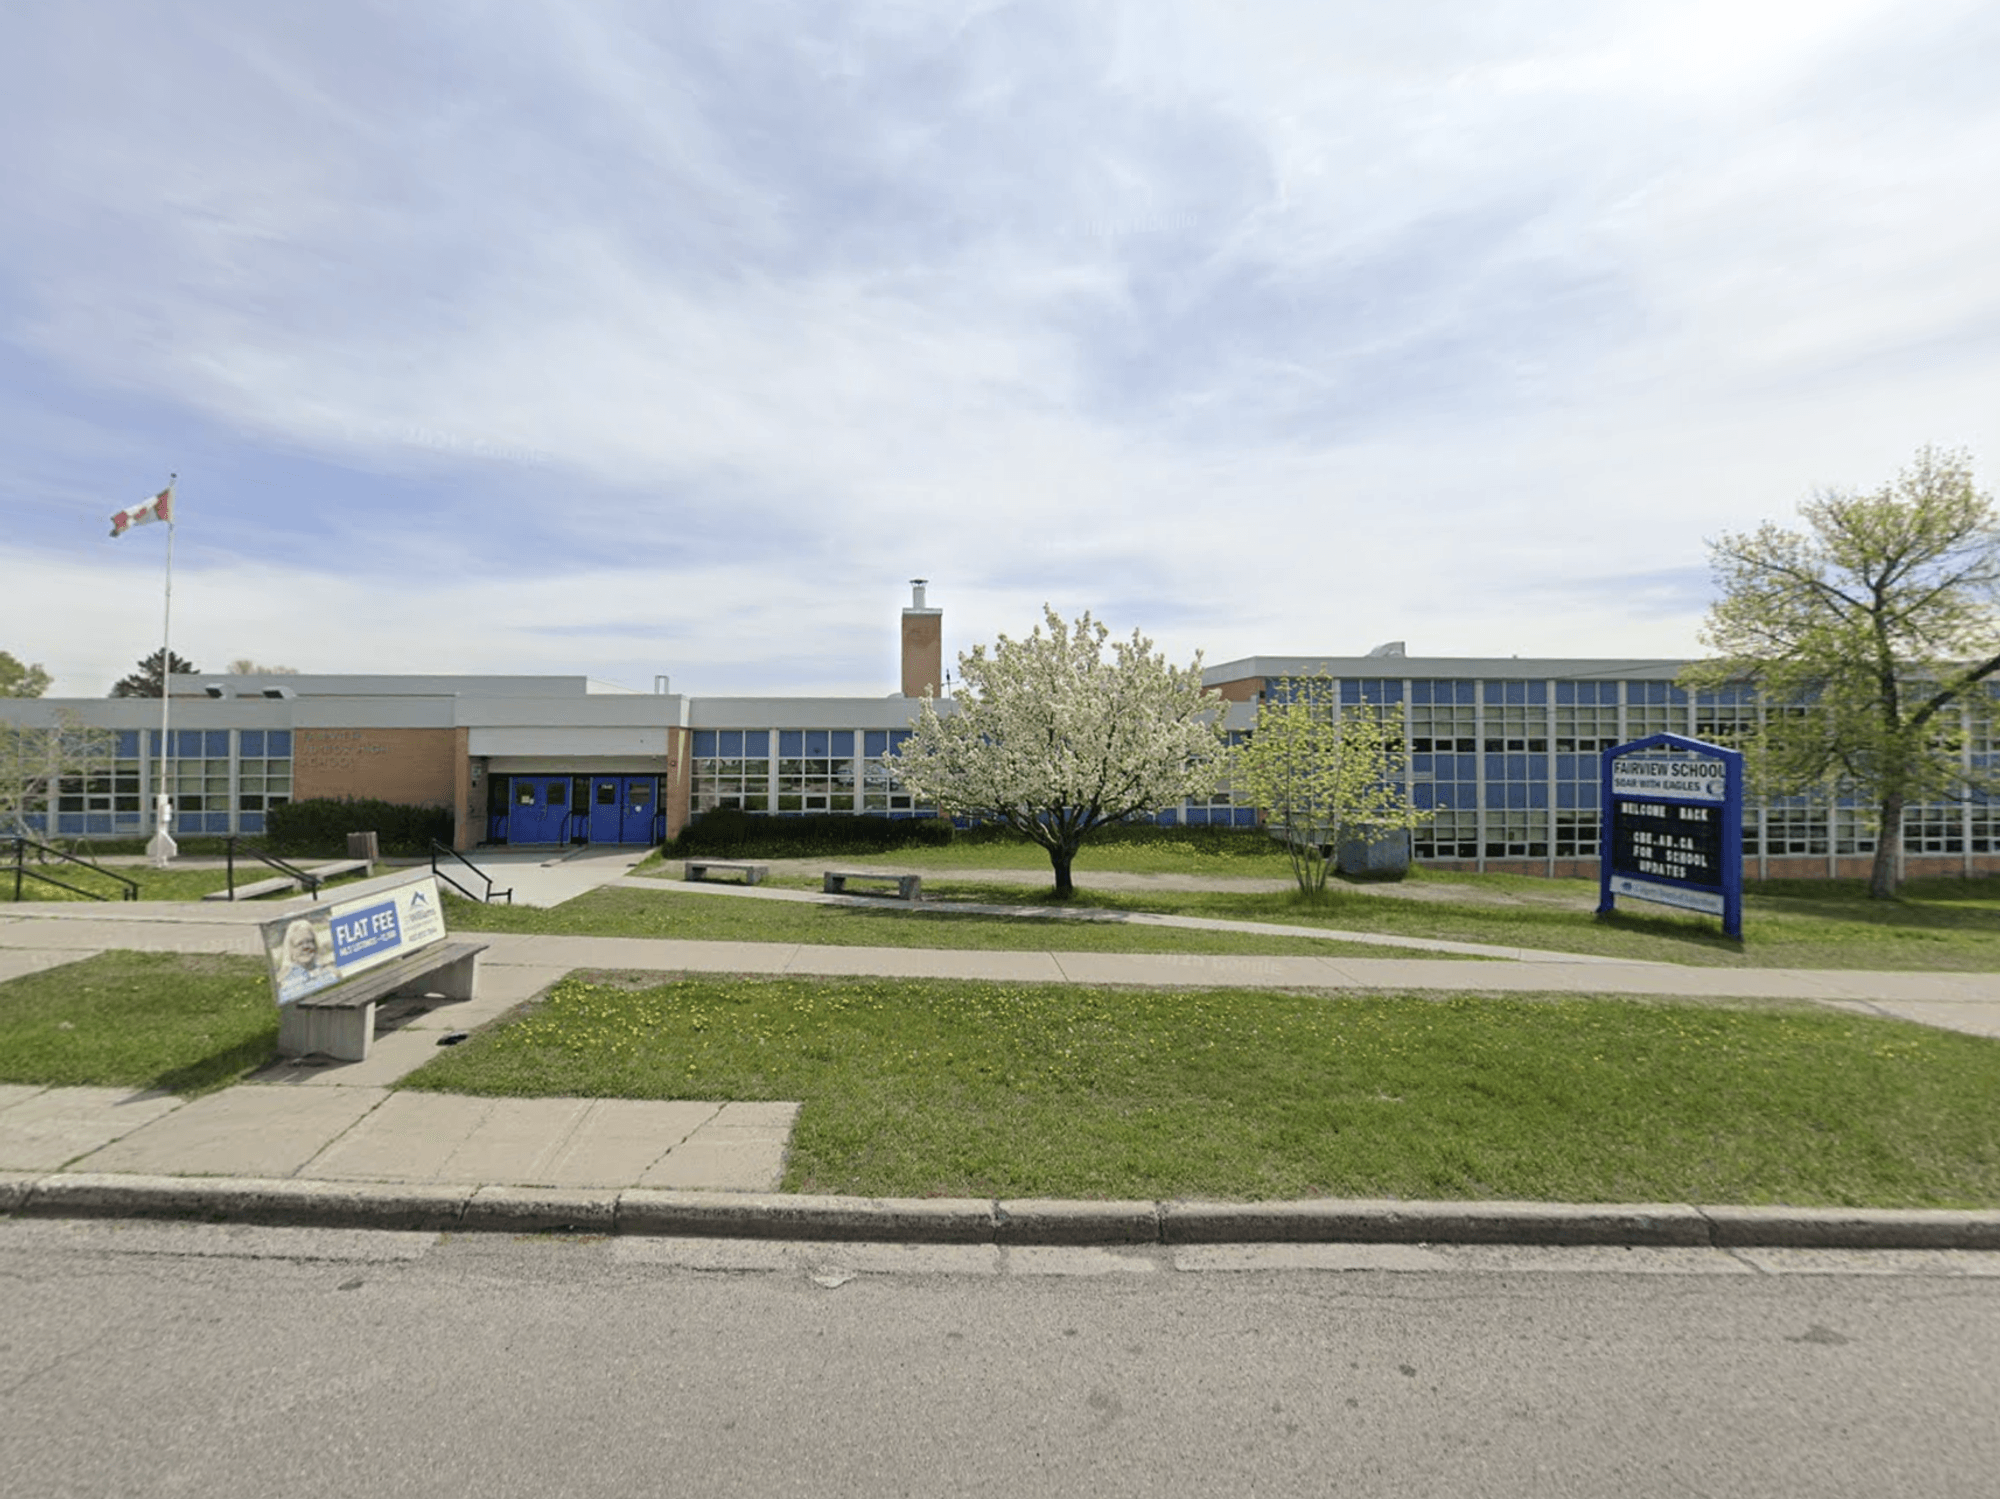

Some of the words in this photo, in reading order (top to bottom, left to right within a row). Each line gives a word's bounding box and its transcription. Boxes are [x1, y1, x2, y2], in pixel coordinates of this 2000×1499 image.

[1614, 762, 1669, 776] FAIRVIEW
[1671, 763, 1725, 778] SCHOOL
[1662, 781, 1701, 792] EAGLES
[1621, 802, 1666, 818] WELCOME
[1679, 807, 1709, 821] BACK
[1633, 845, 1653, 858] FOR
[1666, 850, 1708, 868] SCHOOL
[1639, 860, 1687, 878] UPDATES
[336, 917, 369, 947] FLAT
[371, 909, 396, 935] FEE
